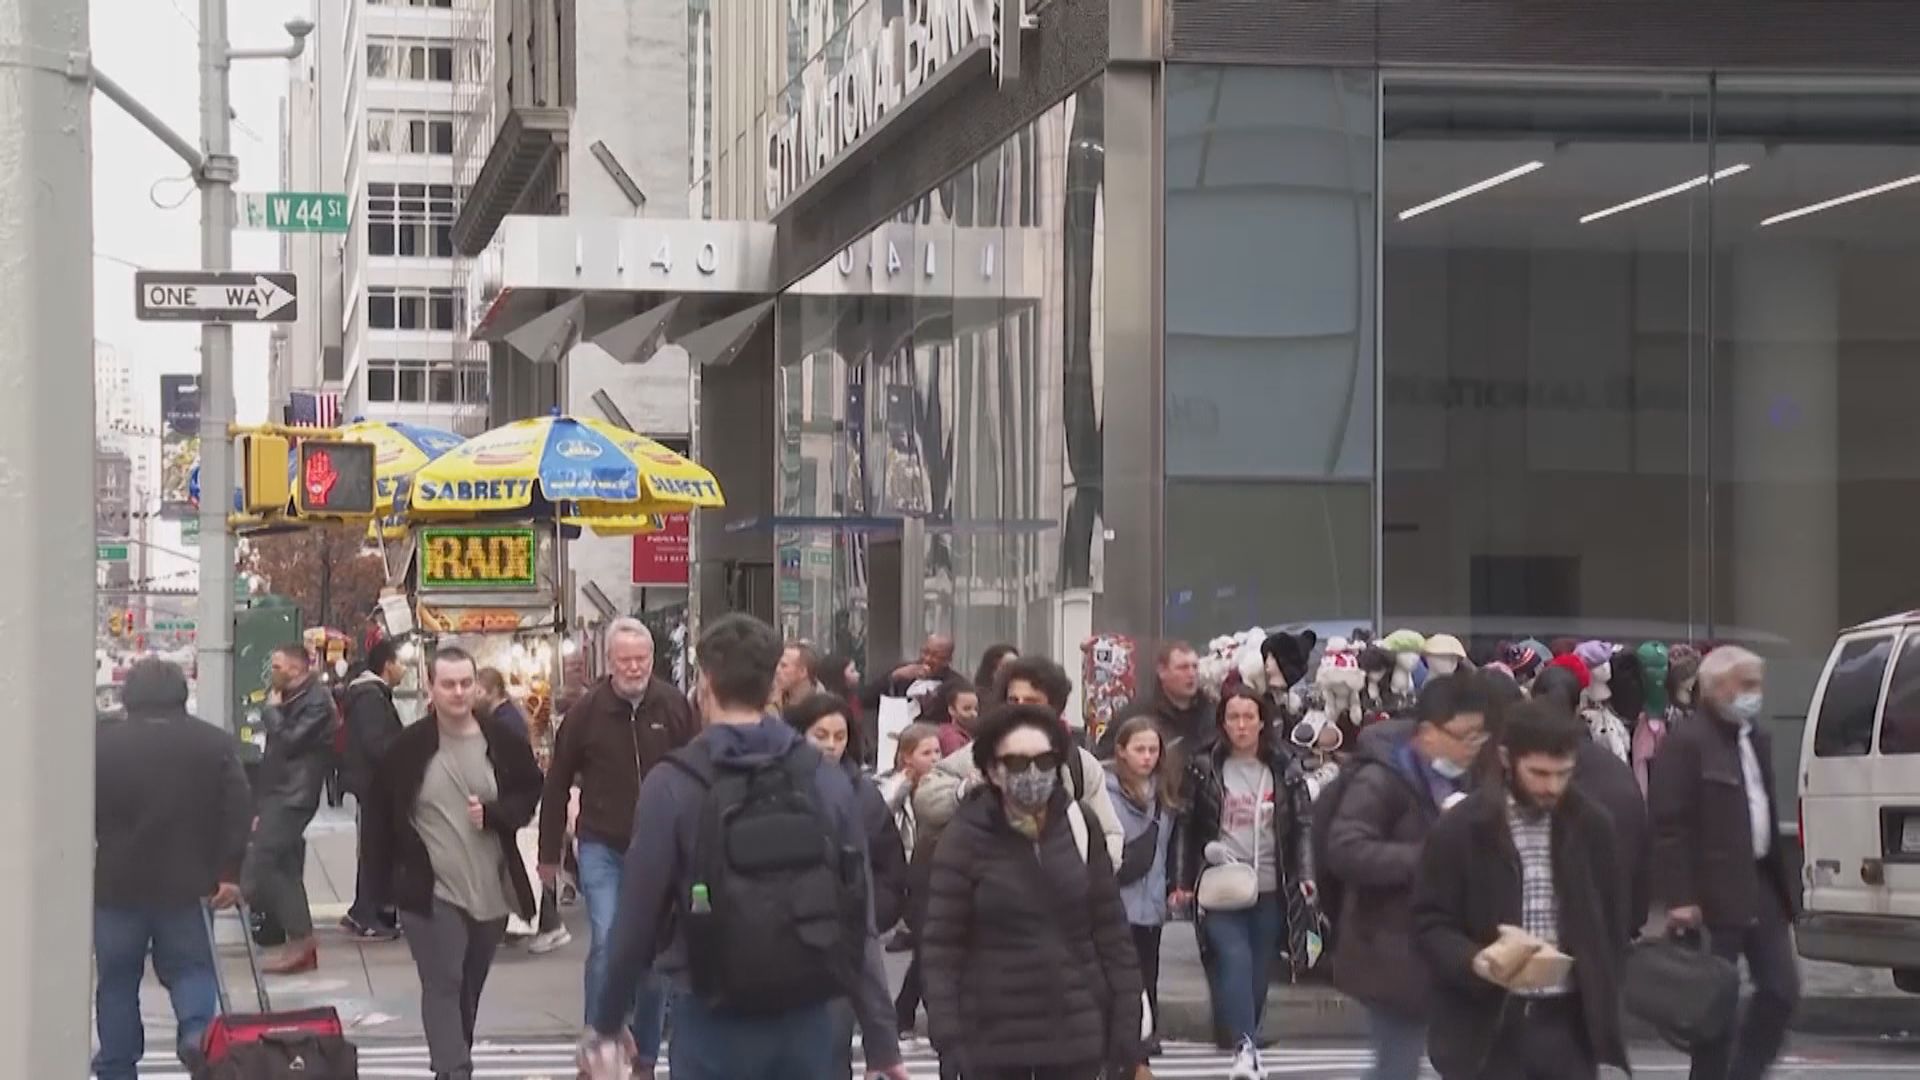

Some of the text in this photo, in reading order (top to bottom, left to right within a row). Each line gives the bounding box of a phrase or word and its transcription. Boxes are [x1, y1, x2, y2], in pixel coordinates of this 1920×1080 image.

[766, 112, 799, 210] CITY
[802, 26, 902, 183] NATIONAL
[273, 198, 290, 226] W
[295, 198, 323, 227] 44
[575, 233, 719, 275] 1140
[150, 287, 275, 306] ONE WAY
[420, 478, 531, 501] SABRETT
